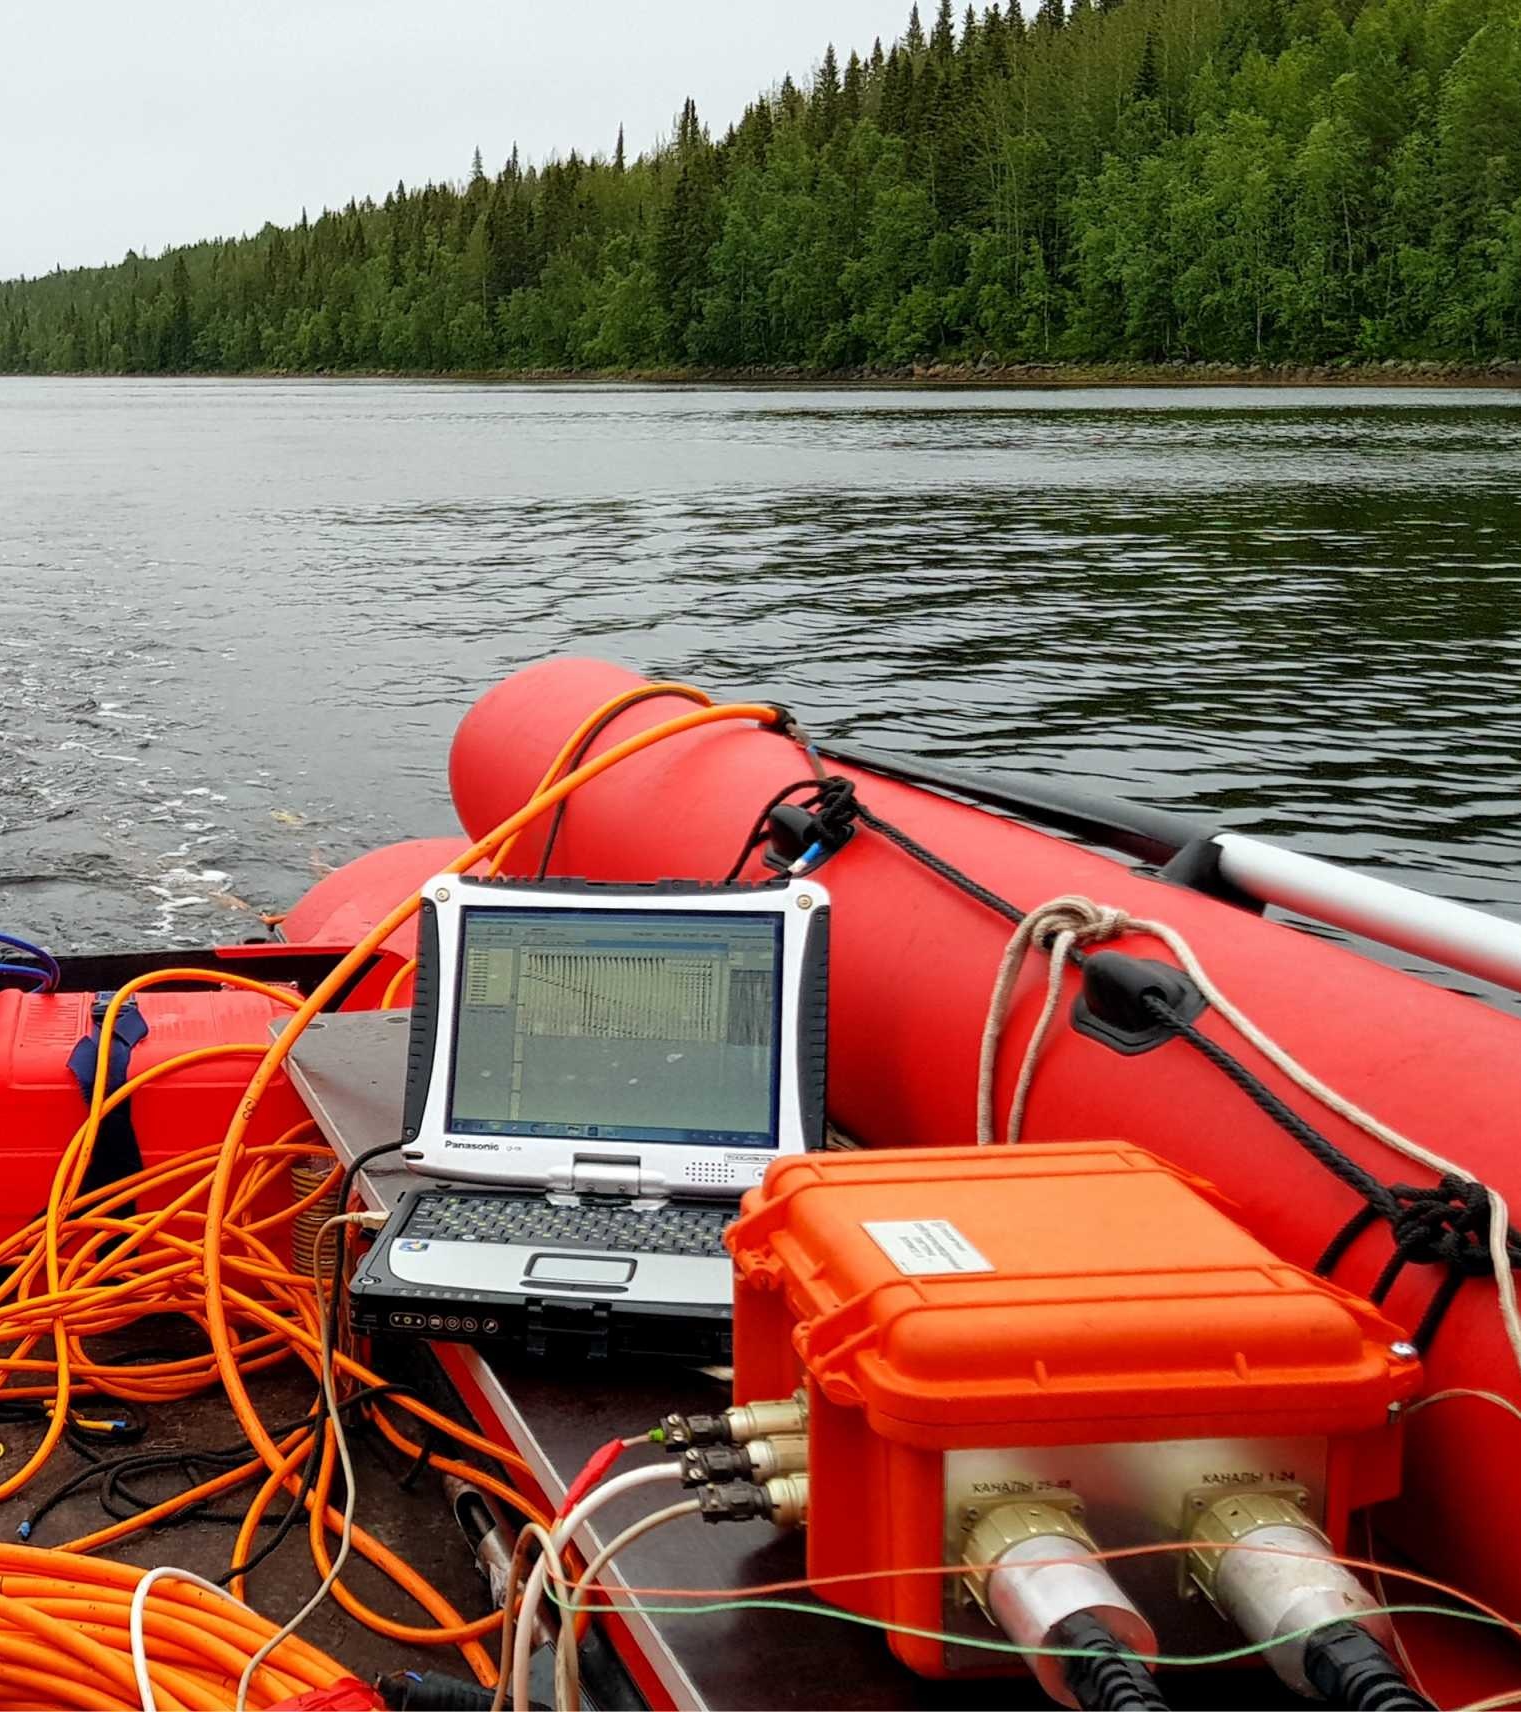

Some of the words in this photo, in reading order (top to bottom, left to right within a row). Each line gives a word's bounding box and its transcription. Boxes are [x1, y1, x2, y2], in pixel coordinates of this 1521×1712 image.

[445, 1139, 500, 1152] Panasonic
[1202, 1471, 1263, 1484] КАНАЛЫ
[972, 1480, 1033, 1494] КАНАЛЫ
